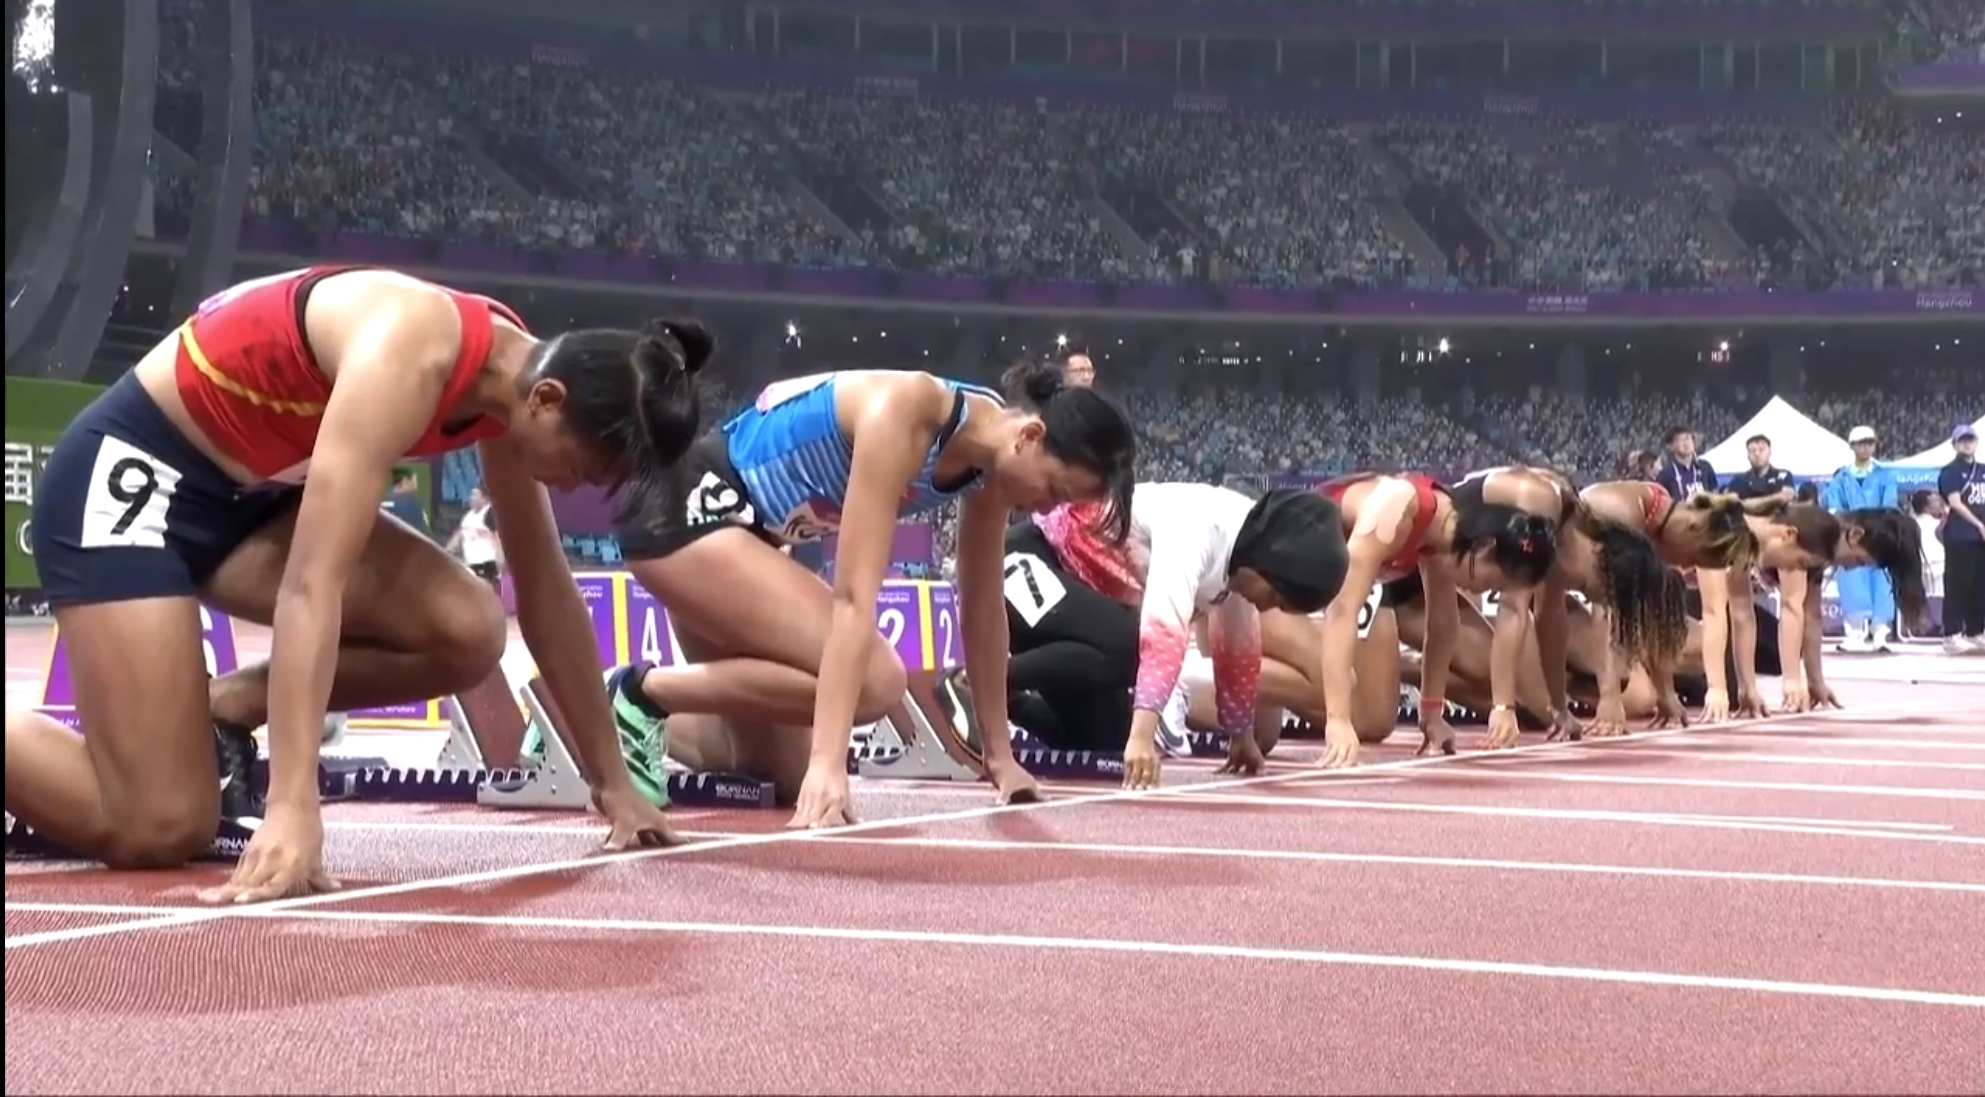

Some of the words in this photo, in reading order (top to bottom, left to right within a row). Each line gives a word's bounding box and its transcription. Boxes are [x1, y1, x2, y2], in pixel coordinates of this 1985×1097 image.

[107, 457, 159, 535] 9
[1004, 558, 1045, 609] 7
[641, 606, 662, 667] 4
[939, 609, 956, 668] 2
